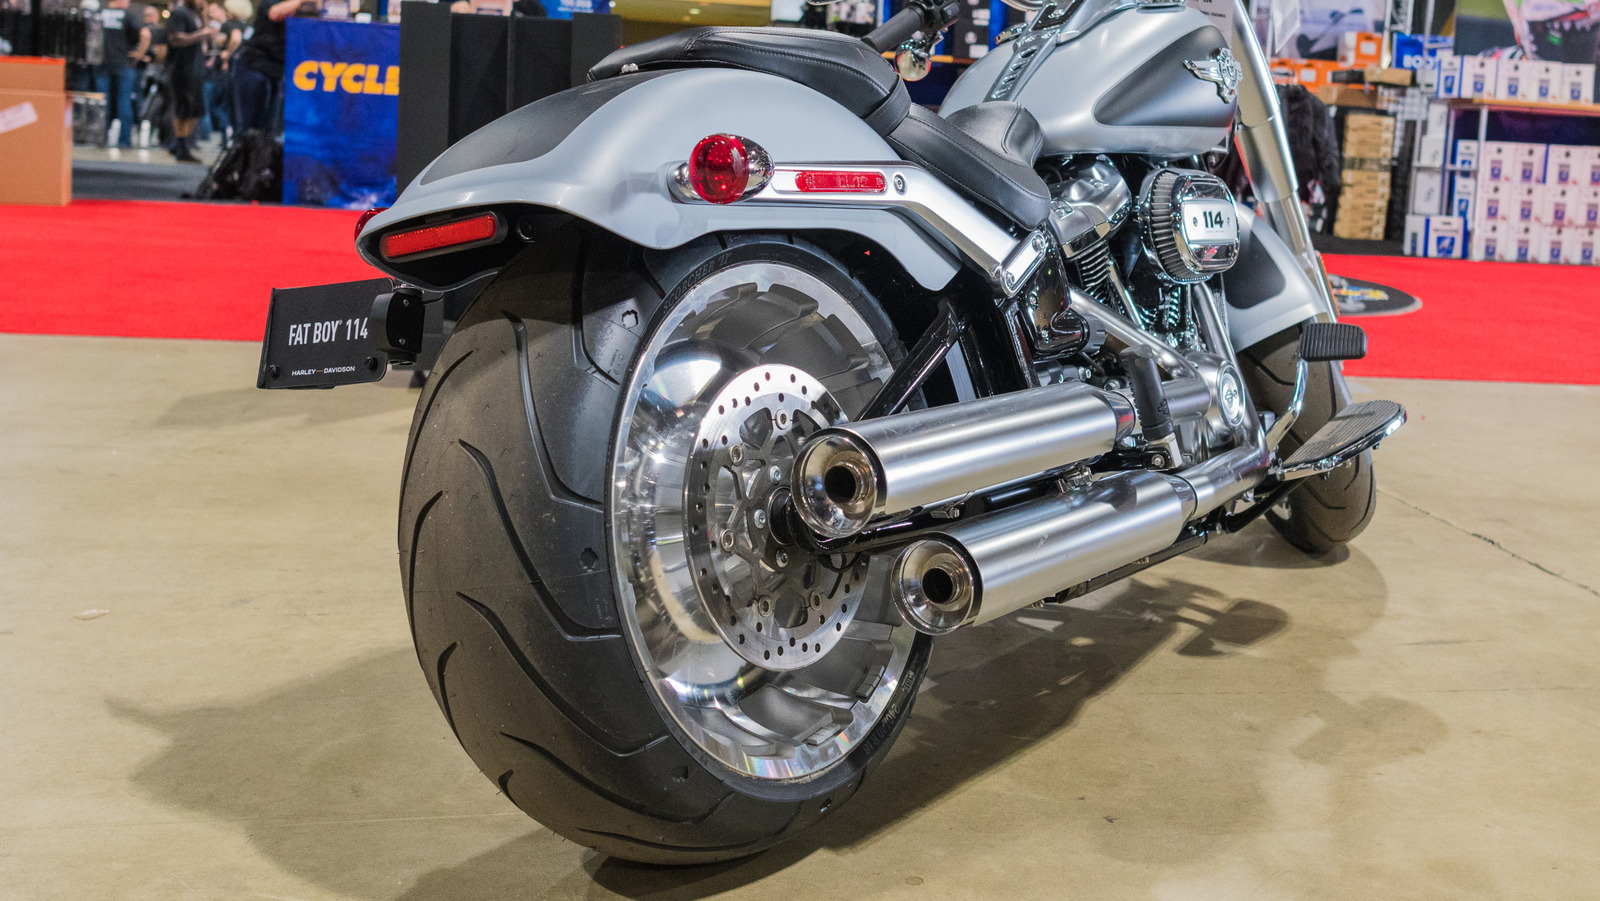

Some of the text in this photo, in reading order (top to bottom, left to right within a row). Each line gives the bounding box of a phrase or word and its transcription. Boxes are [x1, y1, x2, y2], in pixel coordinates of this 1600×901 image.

[1203, 211, 1224, 228] 114
[663, 260, 715, 314] SCORCHER
[288, 322, 311, 346] FAT
[345, 317, 369, 340] 114
